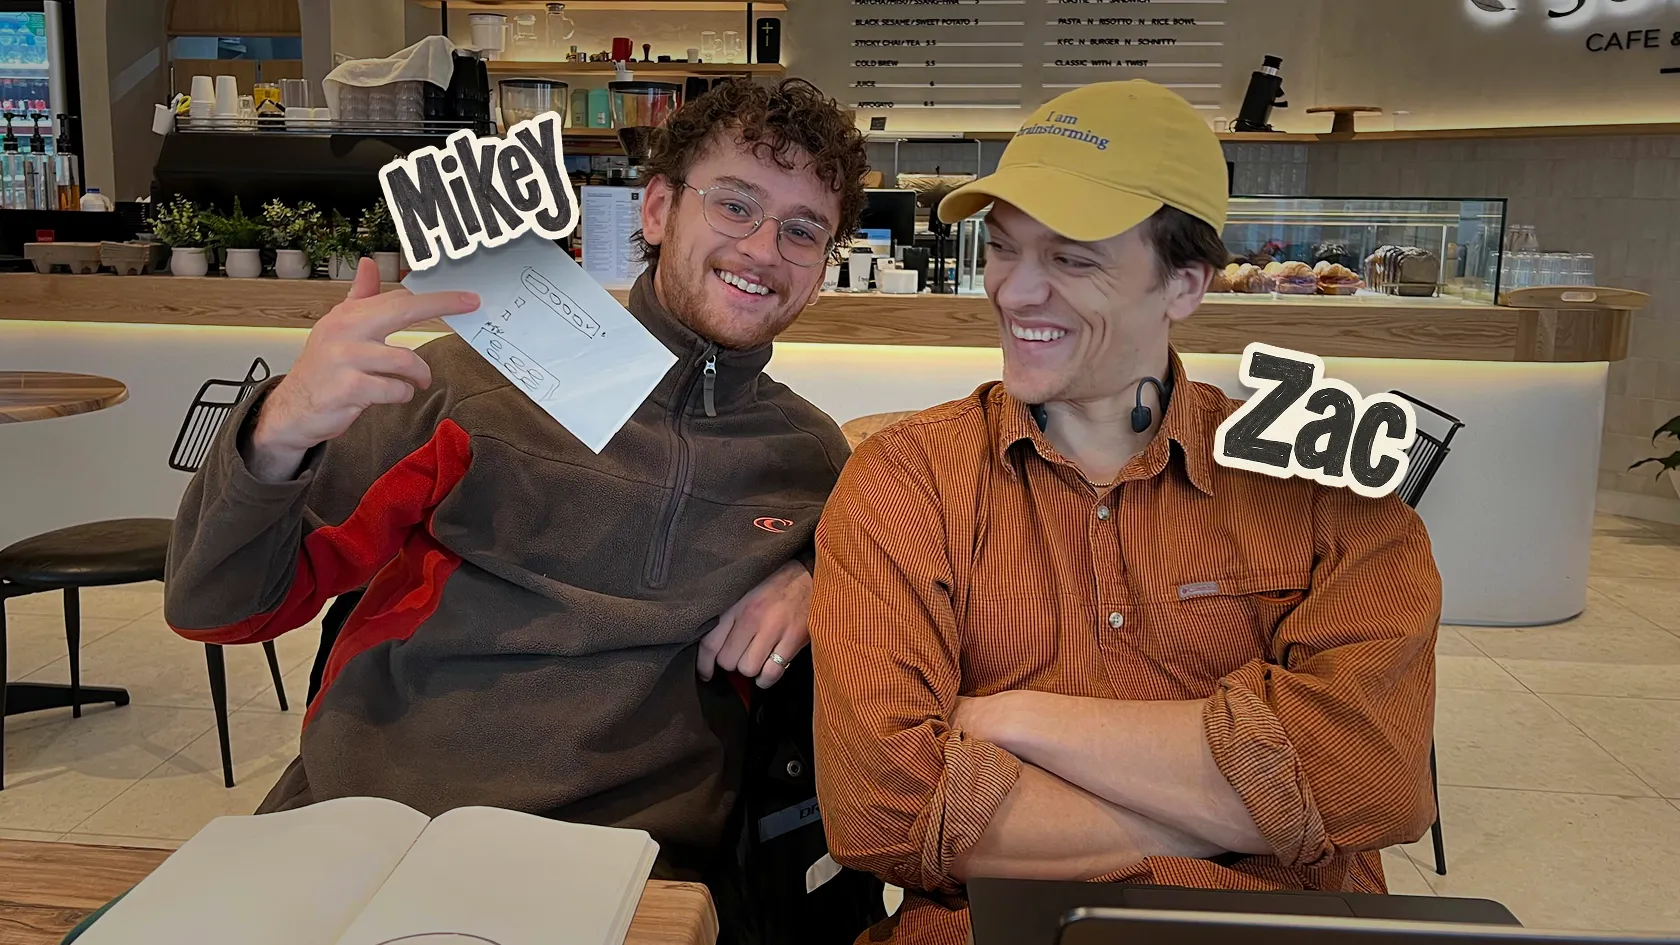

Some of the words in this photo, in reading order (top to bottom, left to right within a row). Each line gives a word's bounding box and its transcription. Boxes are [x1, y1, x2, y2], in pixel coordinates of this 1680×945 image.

[1585, 29, 1661, 52] CAFE
[1045, 111, 1056, 122] I
[1054, 114, 1078, 125] am
